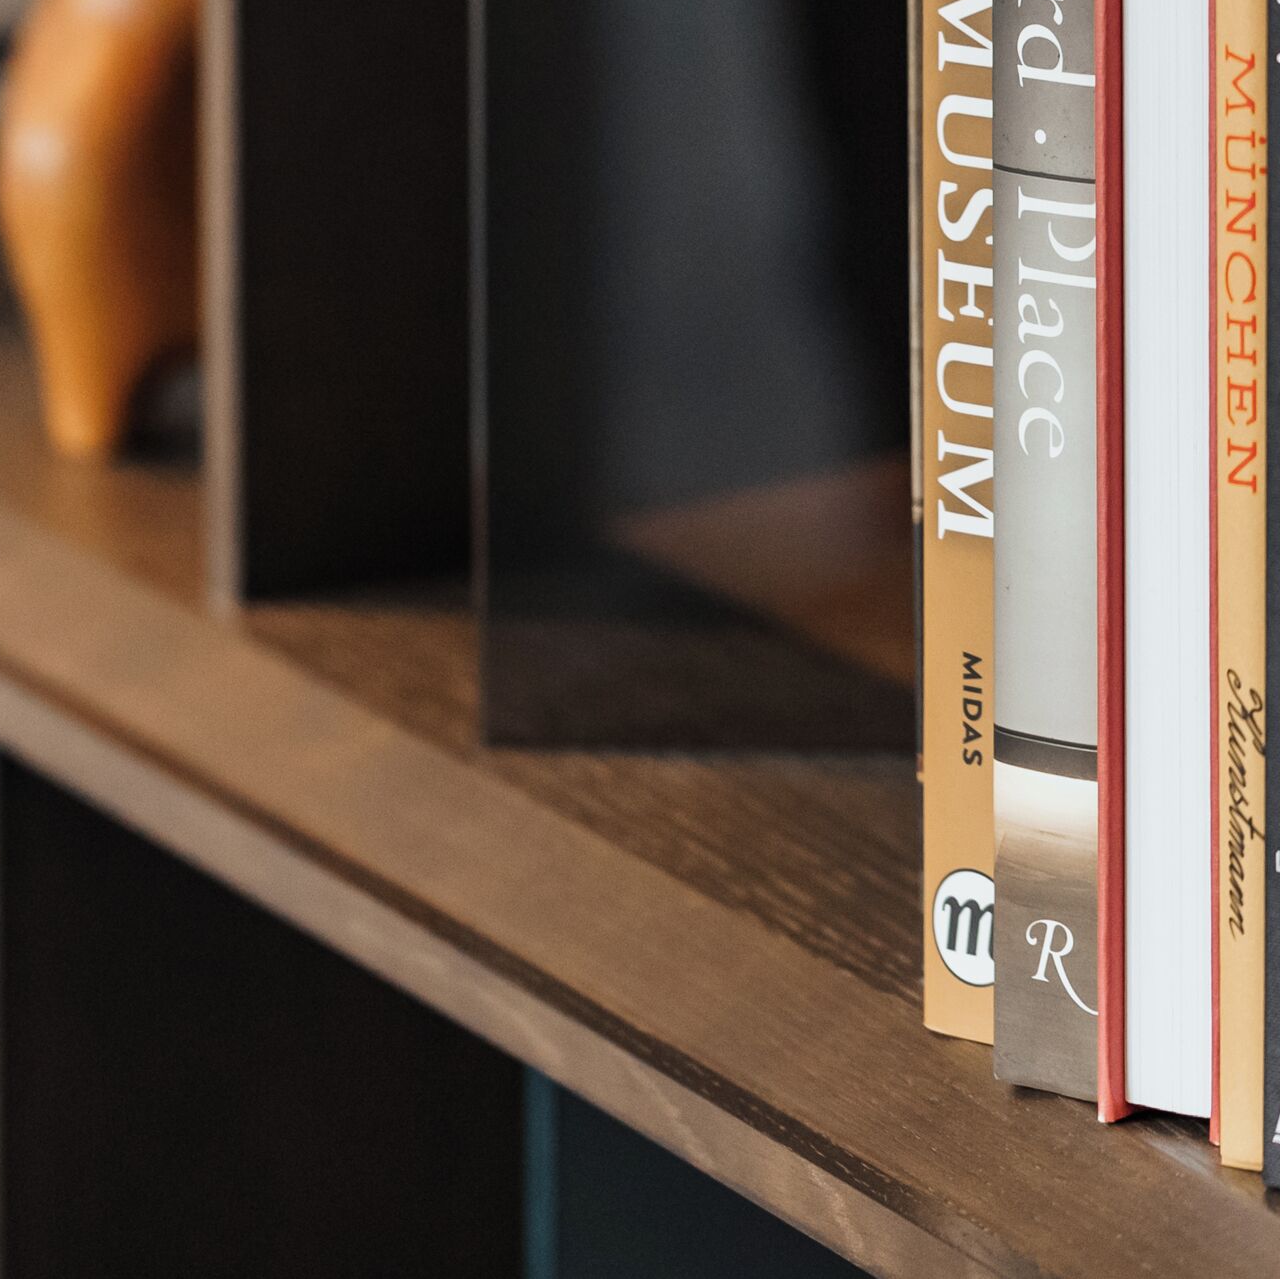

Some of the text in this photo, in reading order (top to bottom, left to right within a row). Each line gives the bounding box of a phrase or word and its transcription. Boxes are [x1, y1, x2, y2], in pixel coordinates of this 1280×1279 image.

[1016, 185, 1097, 460] Place
[1224, 45, 1267, 494] MÜNCHEN
[961, 650, 984, 768] MIDAS
